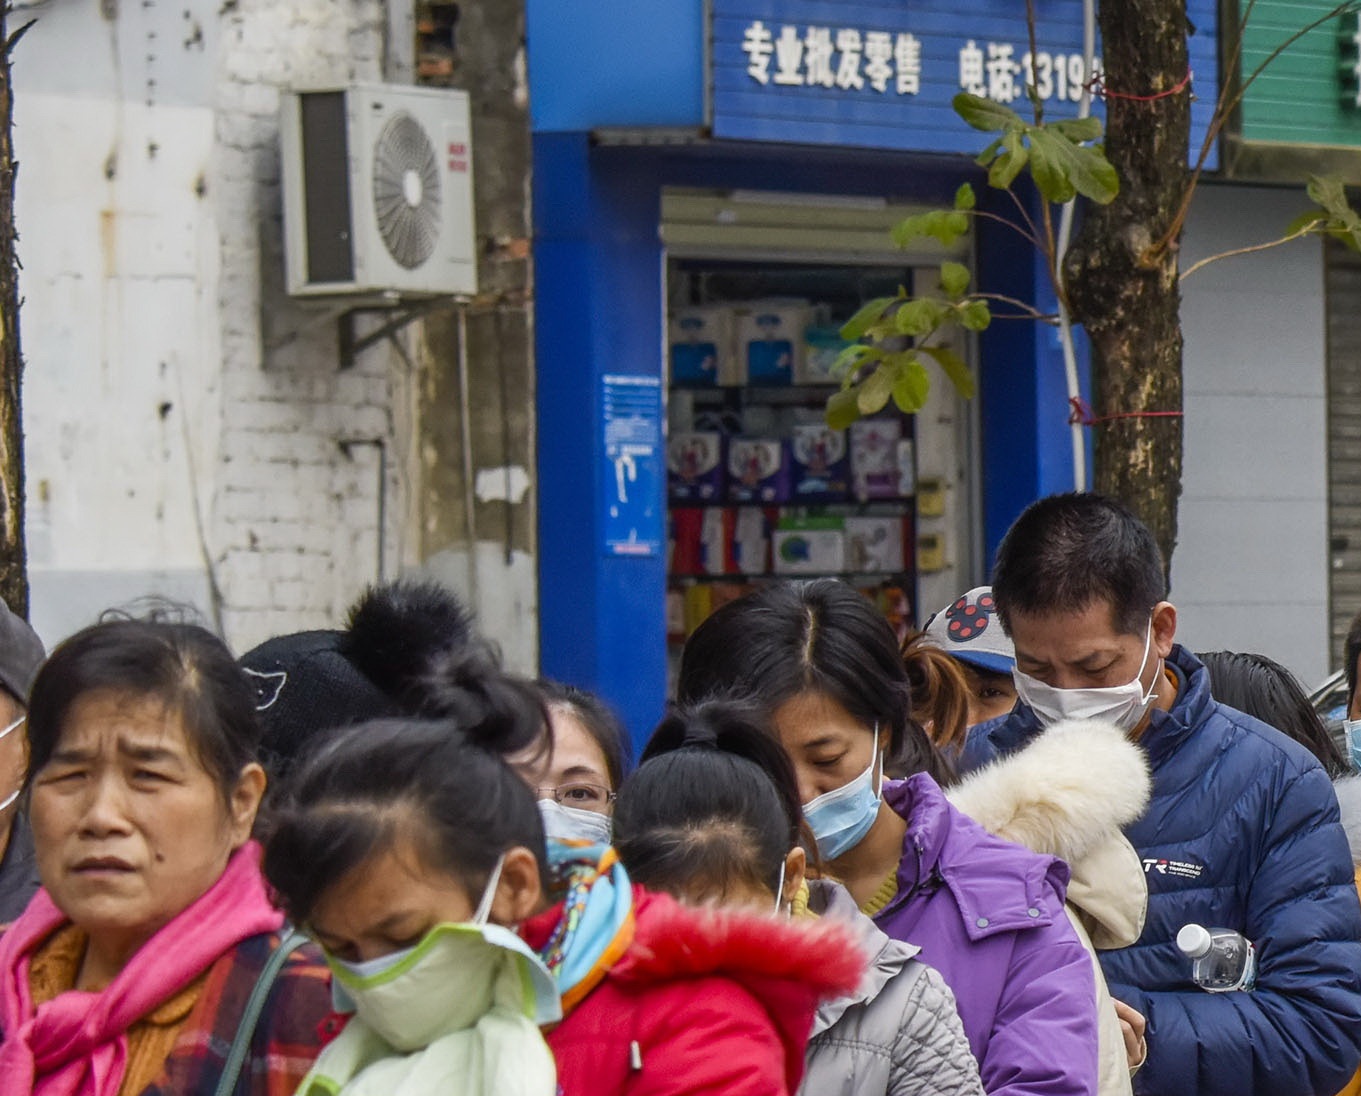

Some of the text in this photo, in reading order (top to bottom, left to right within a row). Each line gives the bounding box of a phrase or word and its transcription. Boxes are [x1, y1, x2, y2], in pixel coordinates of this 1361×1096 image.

[742, 20, 922, 96] 专业批发零售
